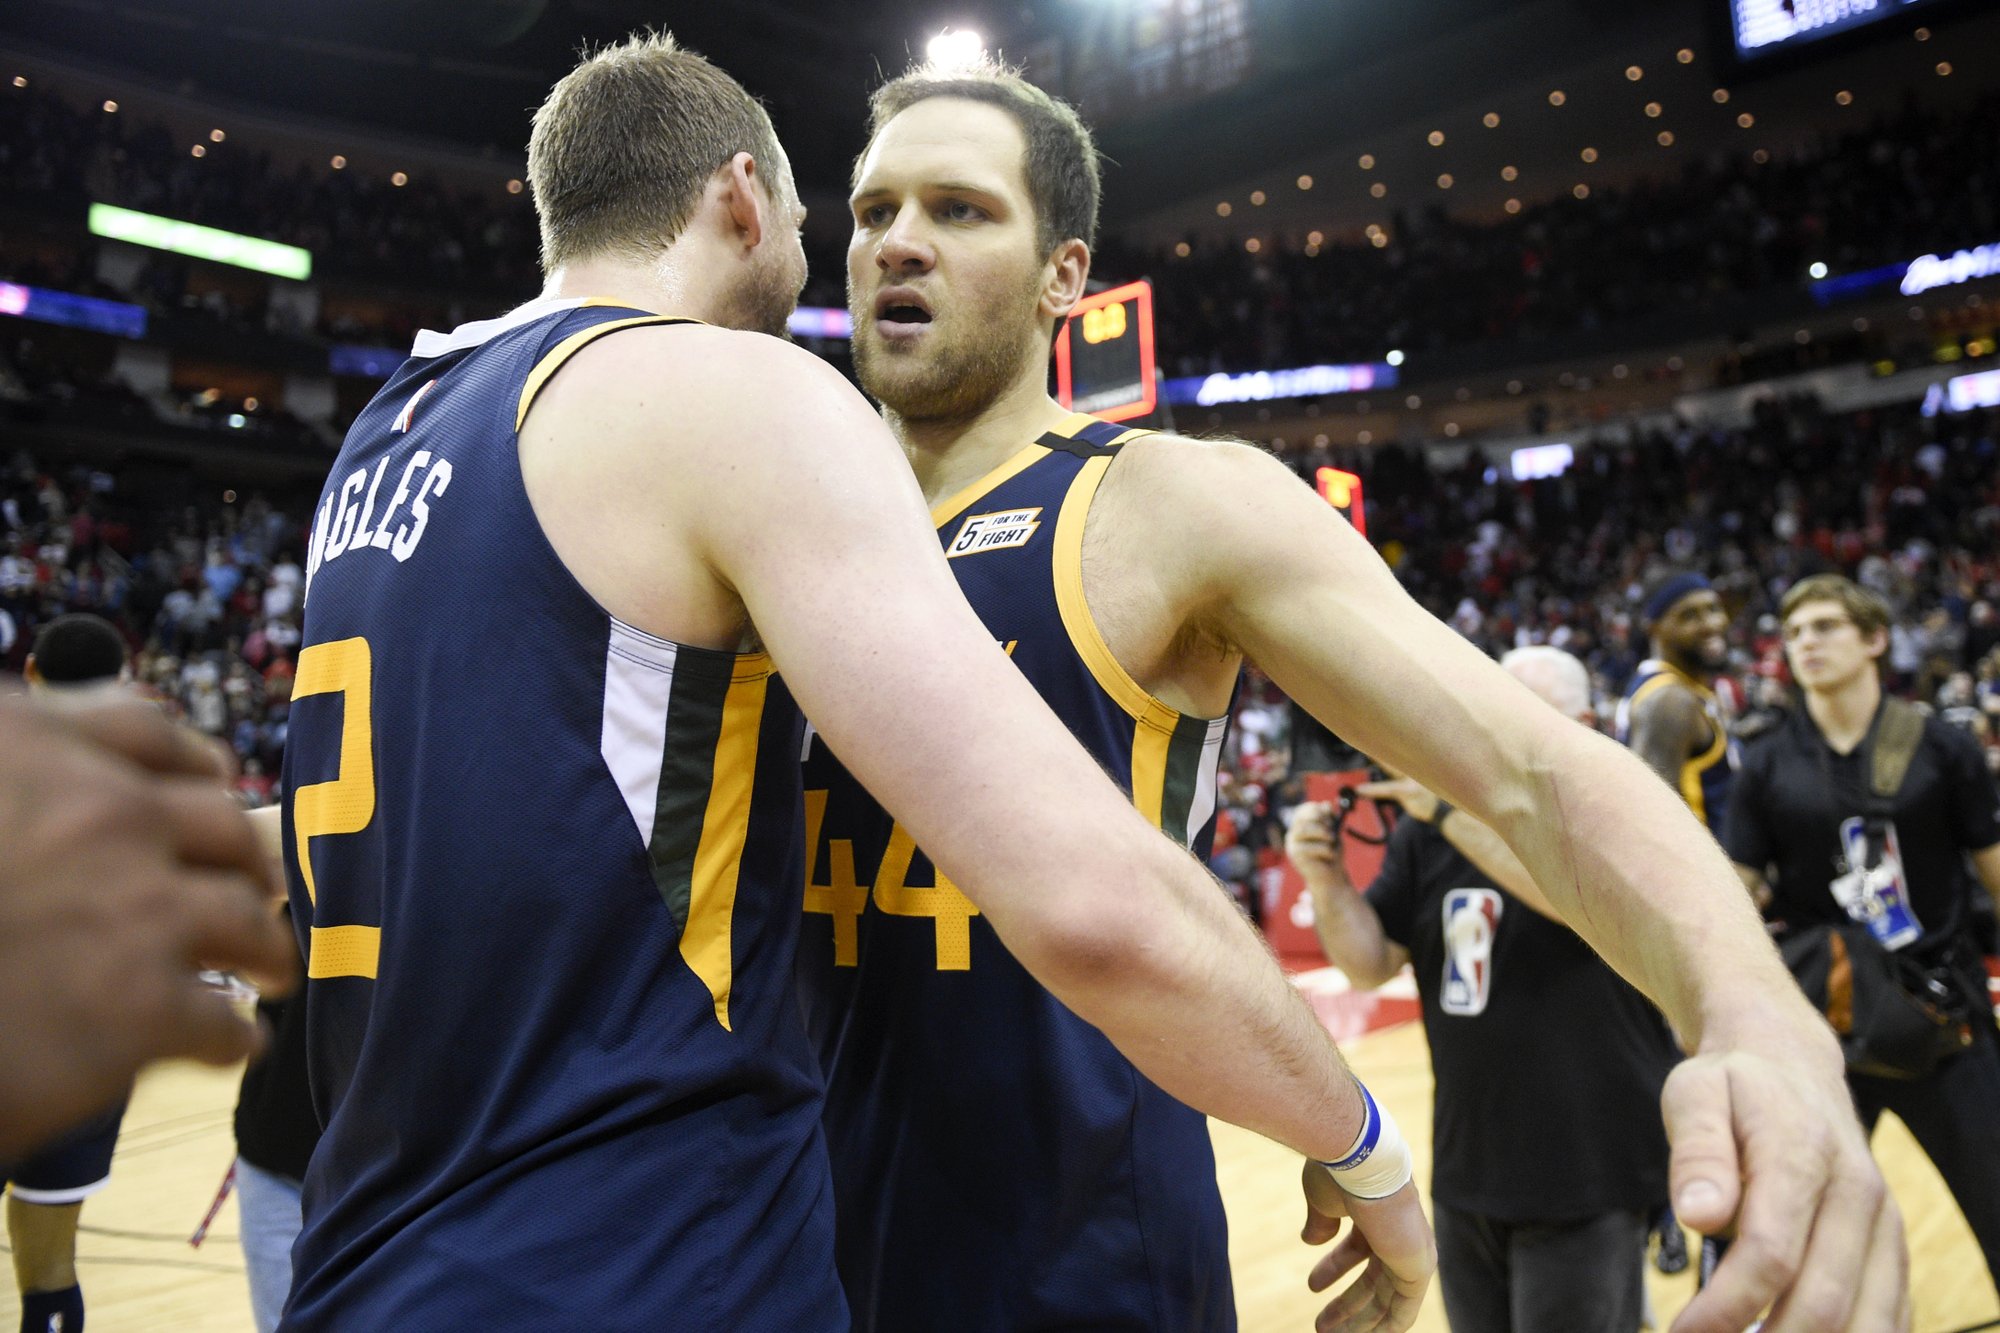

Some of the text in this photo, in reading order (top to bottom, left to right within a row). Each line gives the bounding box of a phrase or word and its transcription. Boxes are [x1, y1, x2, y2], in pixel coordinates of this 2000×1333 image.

[992, 513, 1030, 526] FOR THE
[955, 520, 985, 551] 5
[978, 528, 1029, 547] FIGHT
[290, 636, 381, 979] 2
[802, 789, 980, 971] 44
